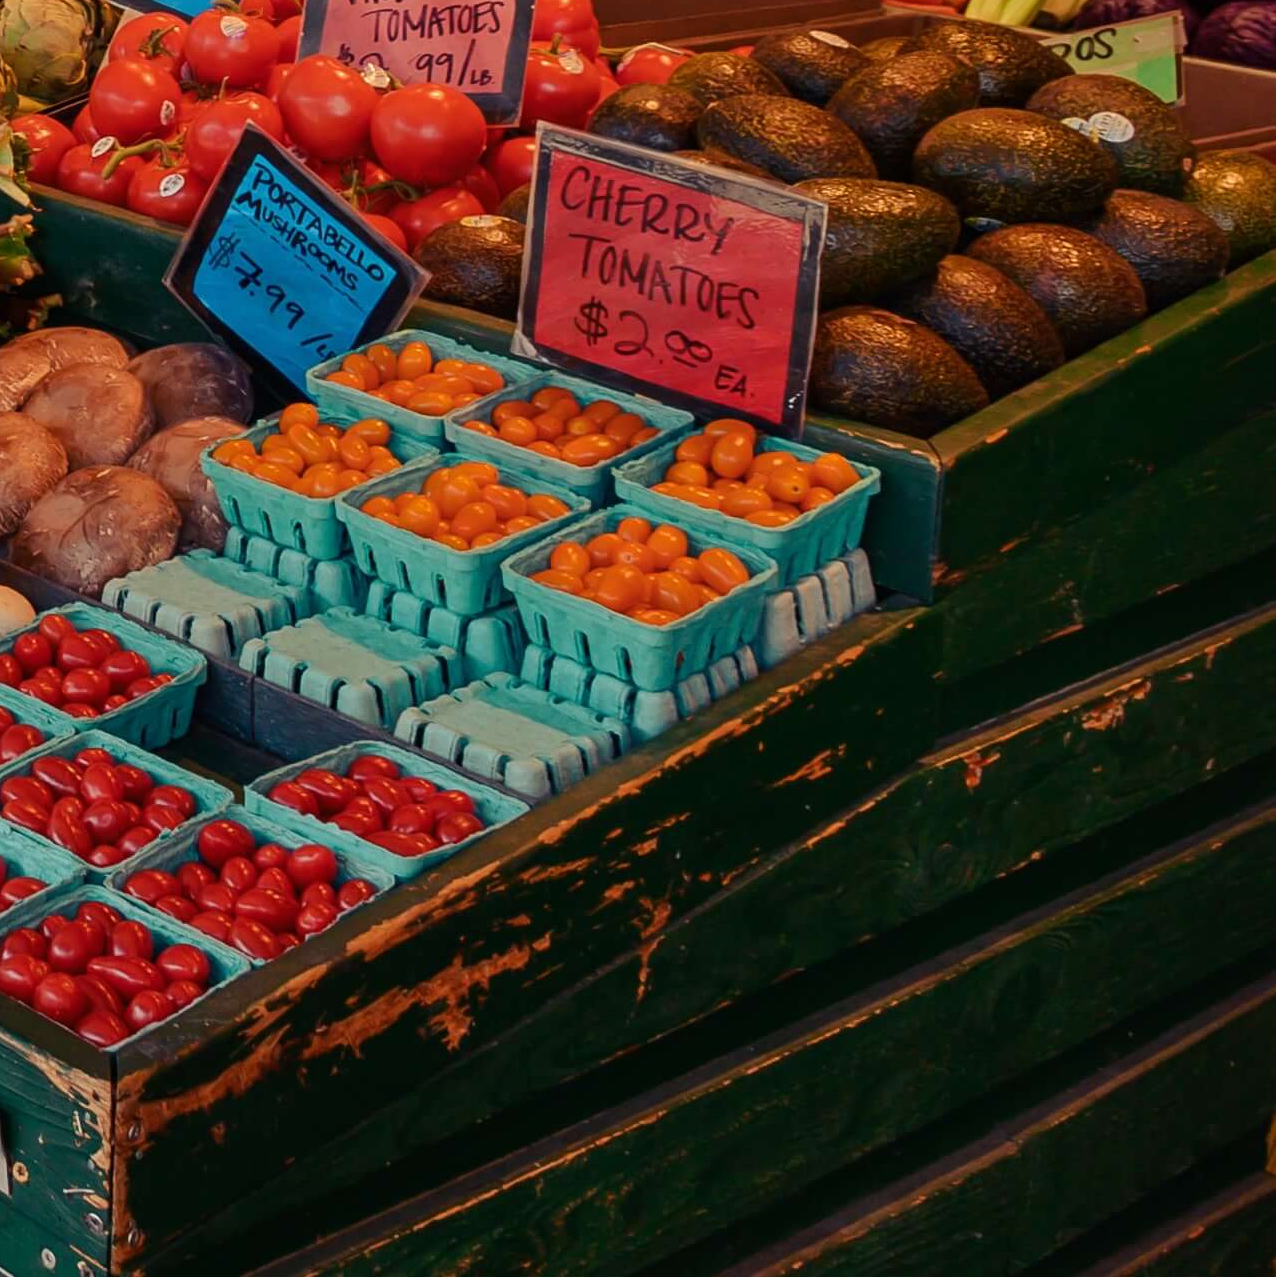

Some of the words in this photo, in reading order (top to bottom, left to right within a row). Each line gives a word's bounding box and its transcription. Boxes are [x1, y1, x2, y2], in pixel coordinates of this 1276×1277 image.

[361, 0, 507, 44] TOMATOES
[236, 191, 357, 292] MUSHROOMS
[254, 161, 386, 283] PORTABELLO
[559, 165, 735, 256] CHERRY
[567, 233, 760, 331] TOMATOES
[713, 364, 755, 399] EA.
